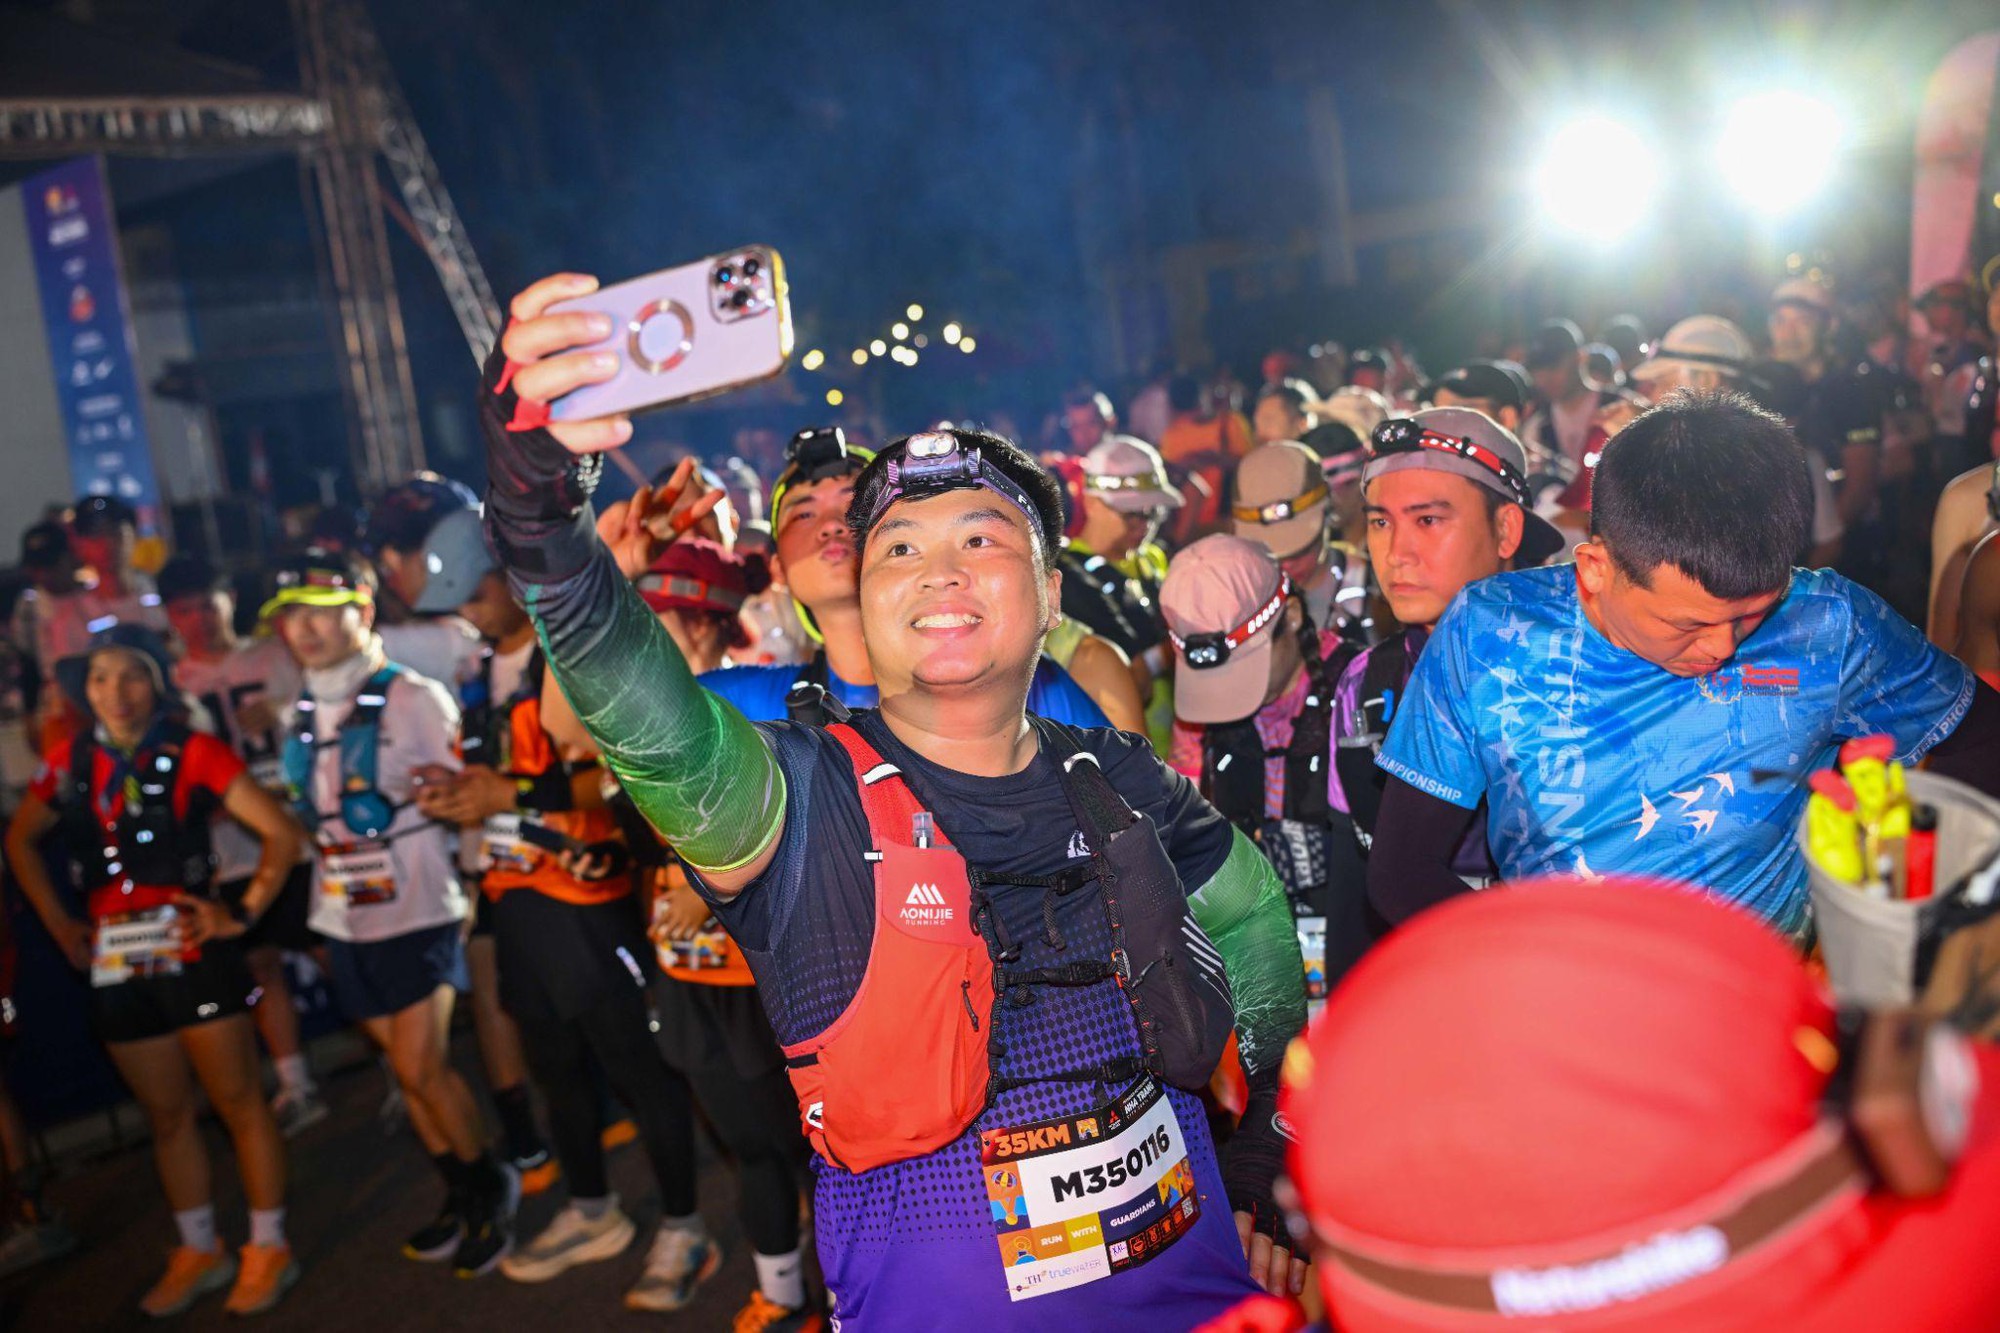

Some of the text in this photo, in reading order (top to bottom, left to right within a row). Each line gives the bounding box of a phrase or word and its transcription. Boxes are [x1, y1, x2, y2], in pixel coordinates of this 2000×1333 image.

[1940, 685, 1974, 735] PHONG
[900, 908, 954, 920] AONIJIE
[1124, 1098, 1139, 1115] NHA
[1136, 1081, 1155, 1102] TRANG
[994, 1124, 1072, 1157] 35KM
[1050, 1124, 1171, 1203] M350116
[1040, 1198, 1156, 1247] RUN WITH GUARDIANS
